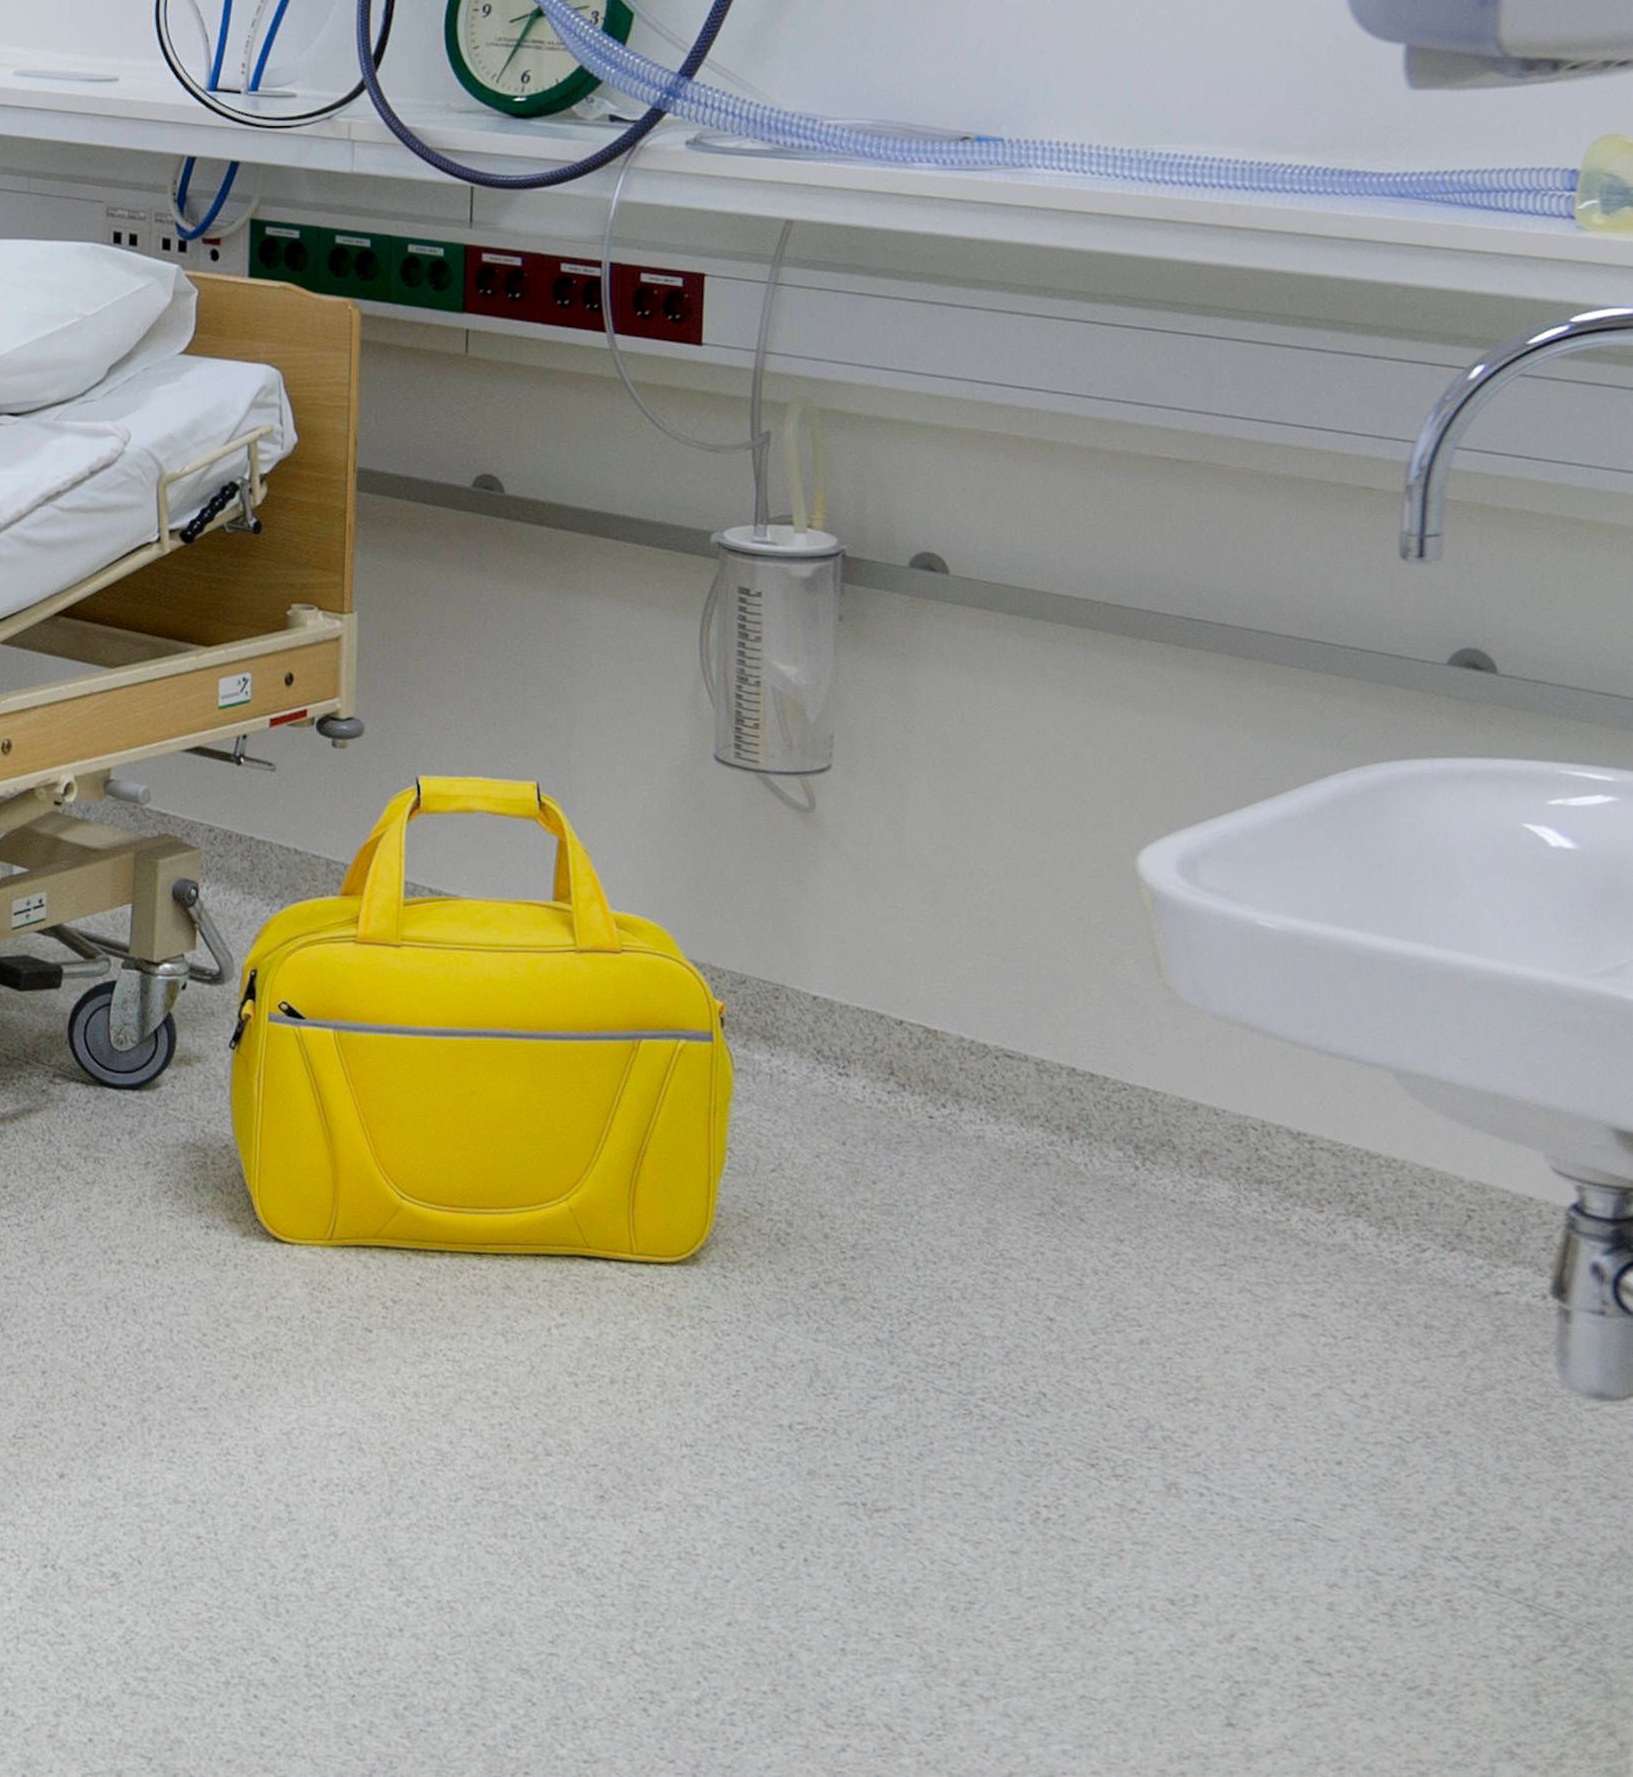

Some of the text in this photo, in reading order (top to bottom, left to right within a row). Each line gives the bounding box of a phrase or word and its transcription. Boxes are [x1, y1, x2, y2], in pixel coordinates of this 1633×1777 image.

[481, 4, 492, 18] 9
[590, 11, 600, 26] 3
[520, 69, 532, 84] 6
